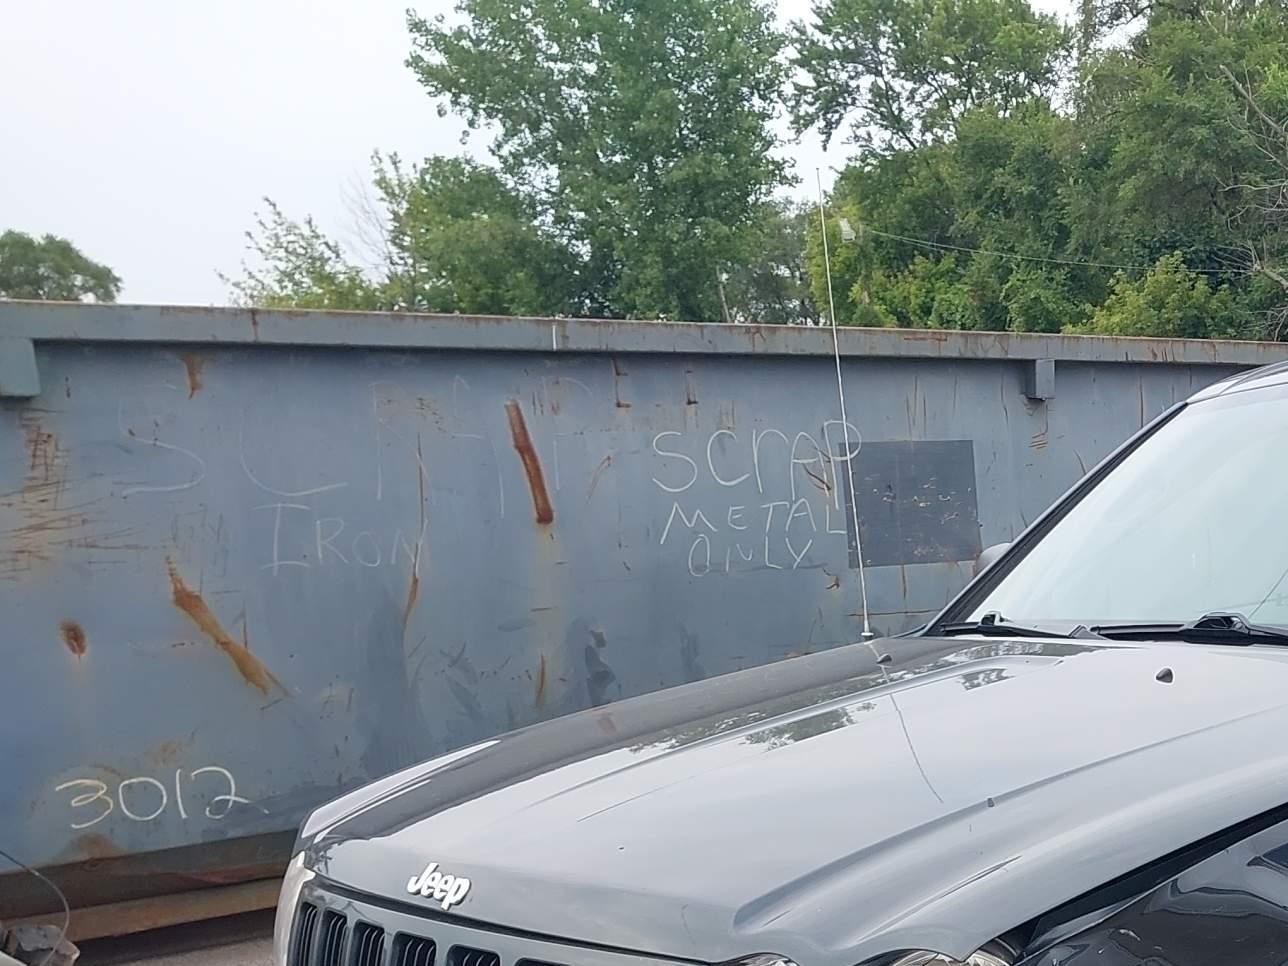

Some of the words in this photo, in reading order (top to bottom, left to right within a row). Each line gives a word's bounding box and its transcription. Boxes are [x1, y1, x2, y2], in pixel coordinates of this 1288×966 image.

[251, 502, 428, 577] IRON
[660, 497, 848, 545] METAL
[687, 533, 814, 578] ONLY
[55, 766, 270, 829] 3012
[406, 861, 472, 912] Jeep
